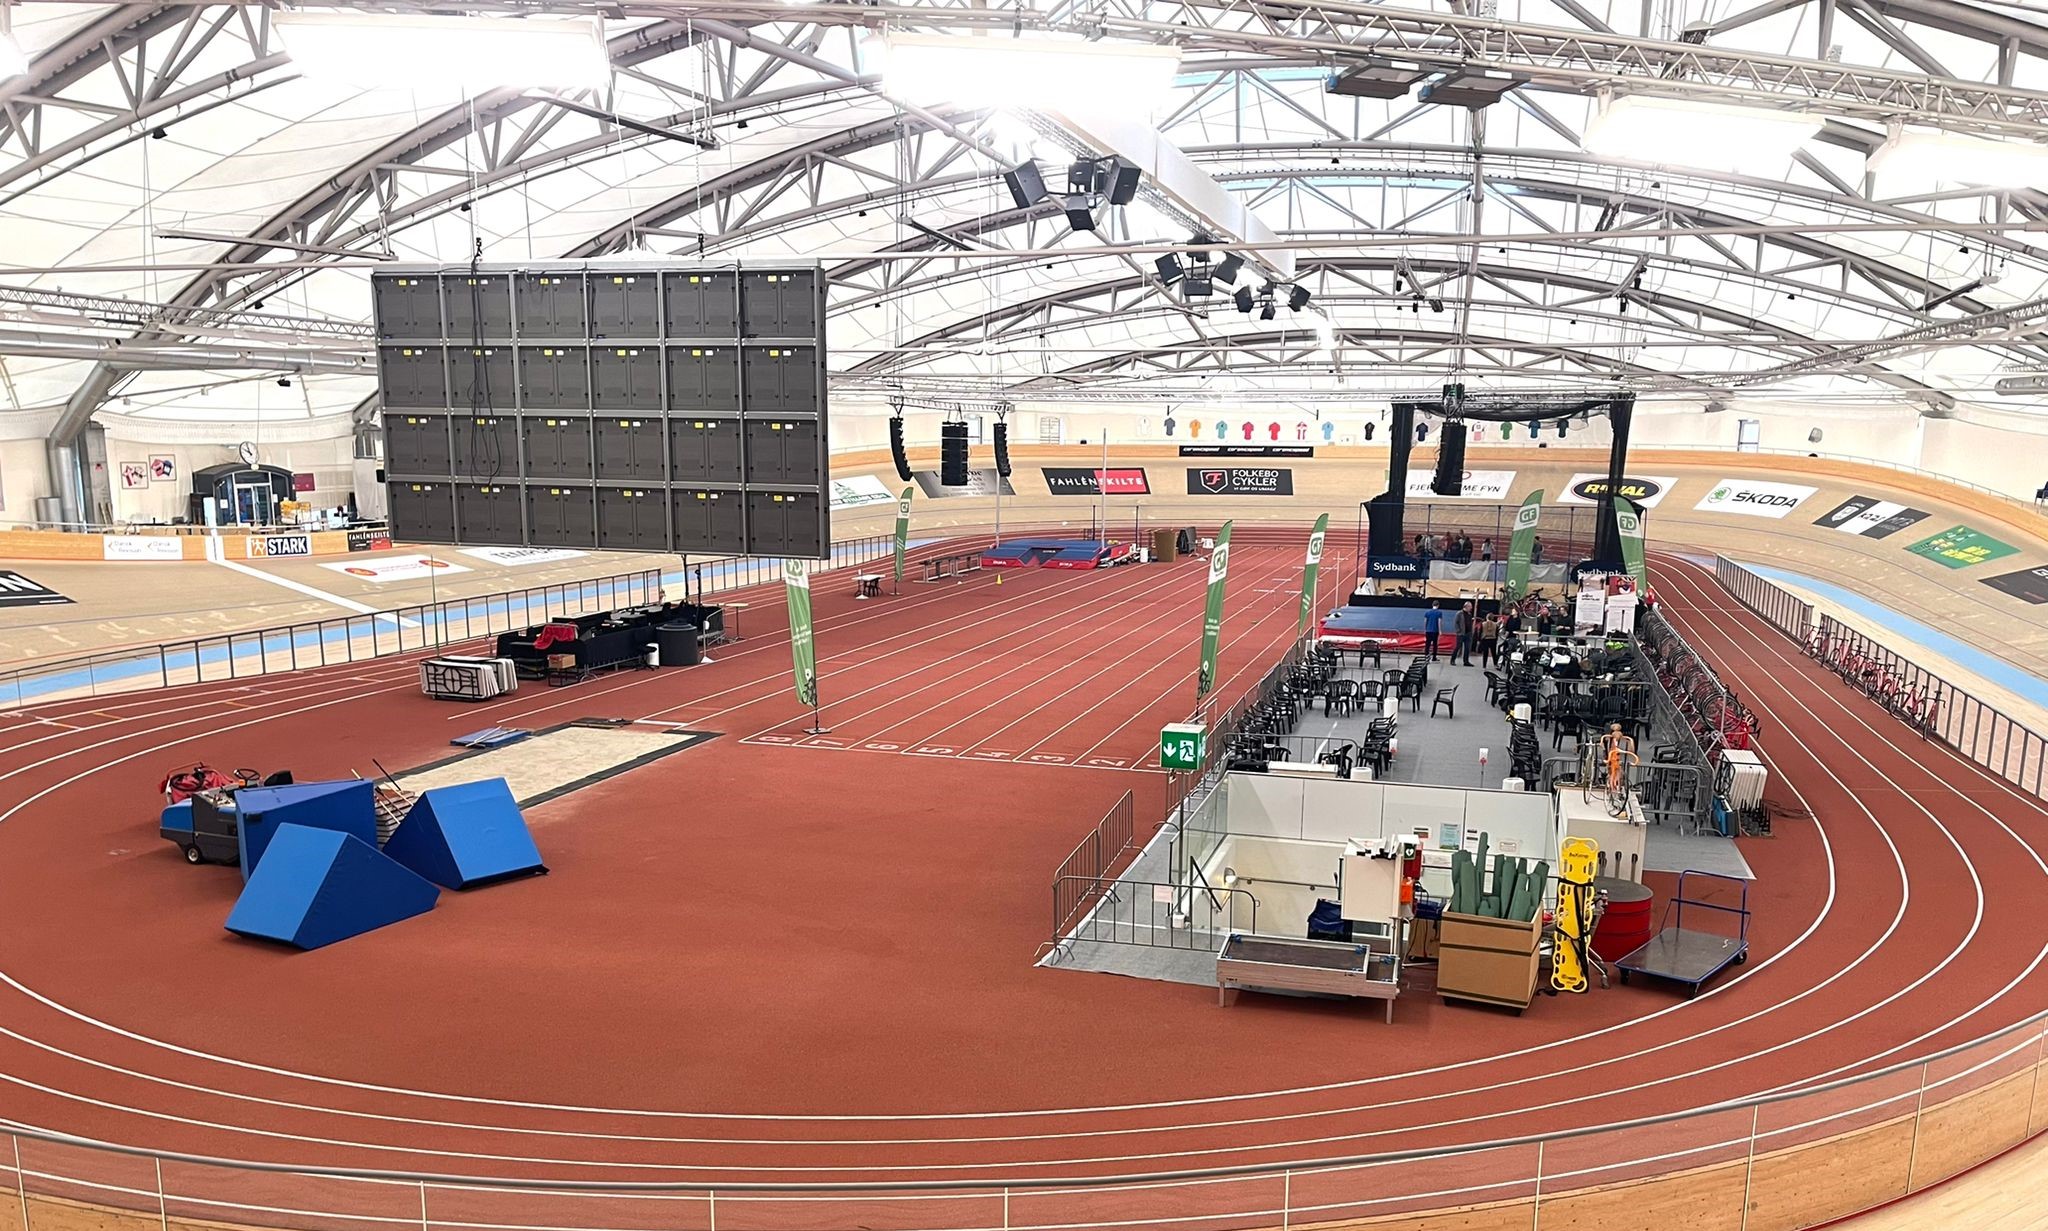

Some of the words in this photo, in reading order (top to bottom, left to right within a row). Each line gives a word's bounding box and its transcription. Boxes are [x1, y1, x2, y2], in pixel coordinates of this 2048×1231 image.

[1232, 469, 1279, 478] FOLKEBO
[1232, 477, 1277, 487] CYKLER
[1479, 484, 1501, 493] FYN
[1731, 489, 1798, 508] ŠKODA
[1521, 508, 1535, 522] GF
[267, 536, 308, 555] STARK
[1373, 561, 1416, 573] Sydbank
[758, 735, 793, 743] 8
[916, 746, 953, 755] 5
[974, 750, 1010, 759] 4
[1030, 754, 1066, 763] 3
[1088, 759, 1126, 767] 2
